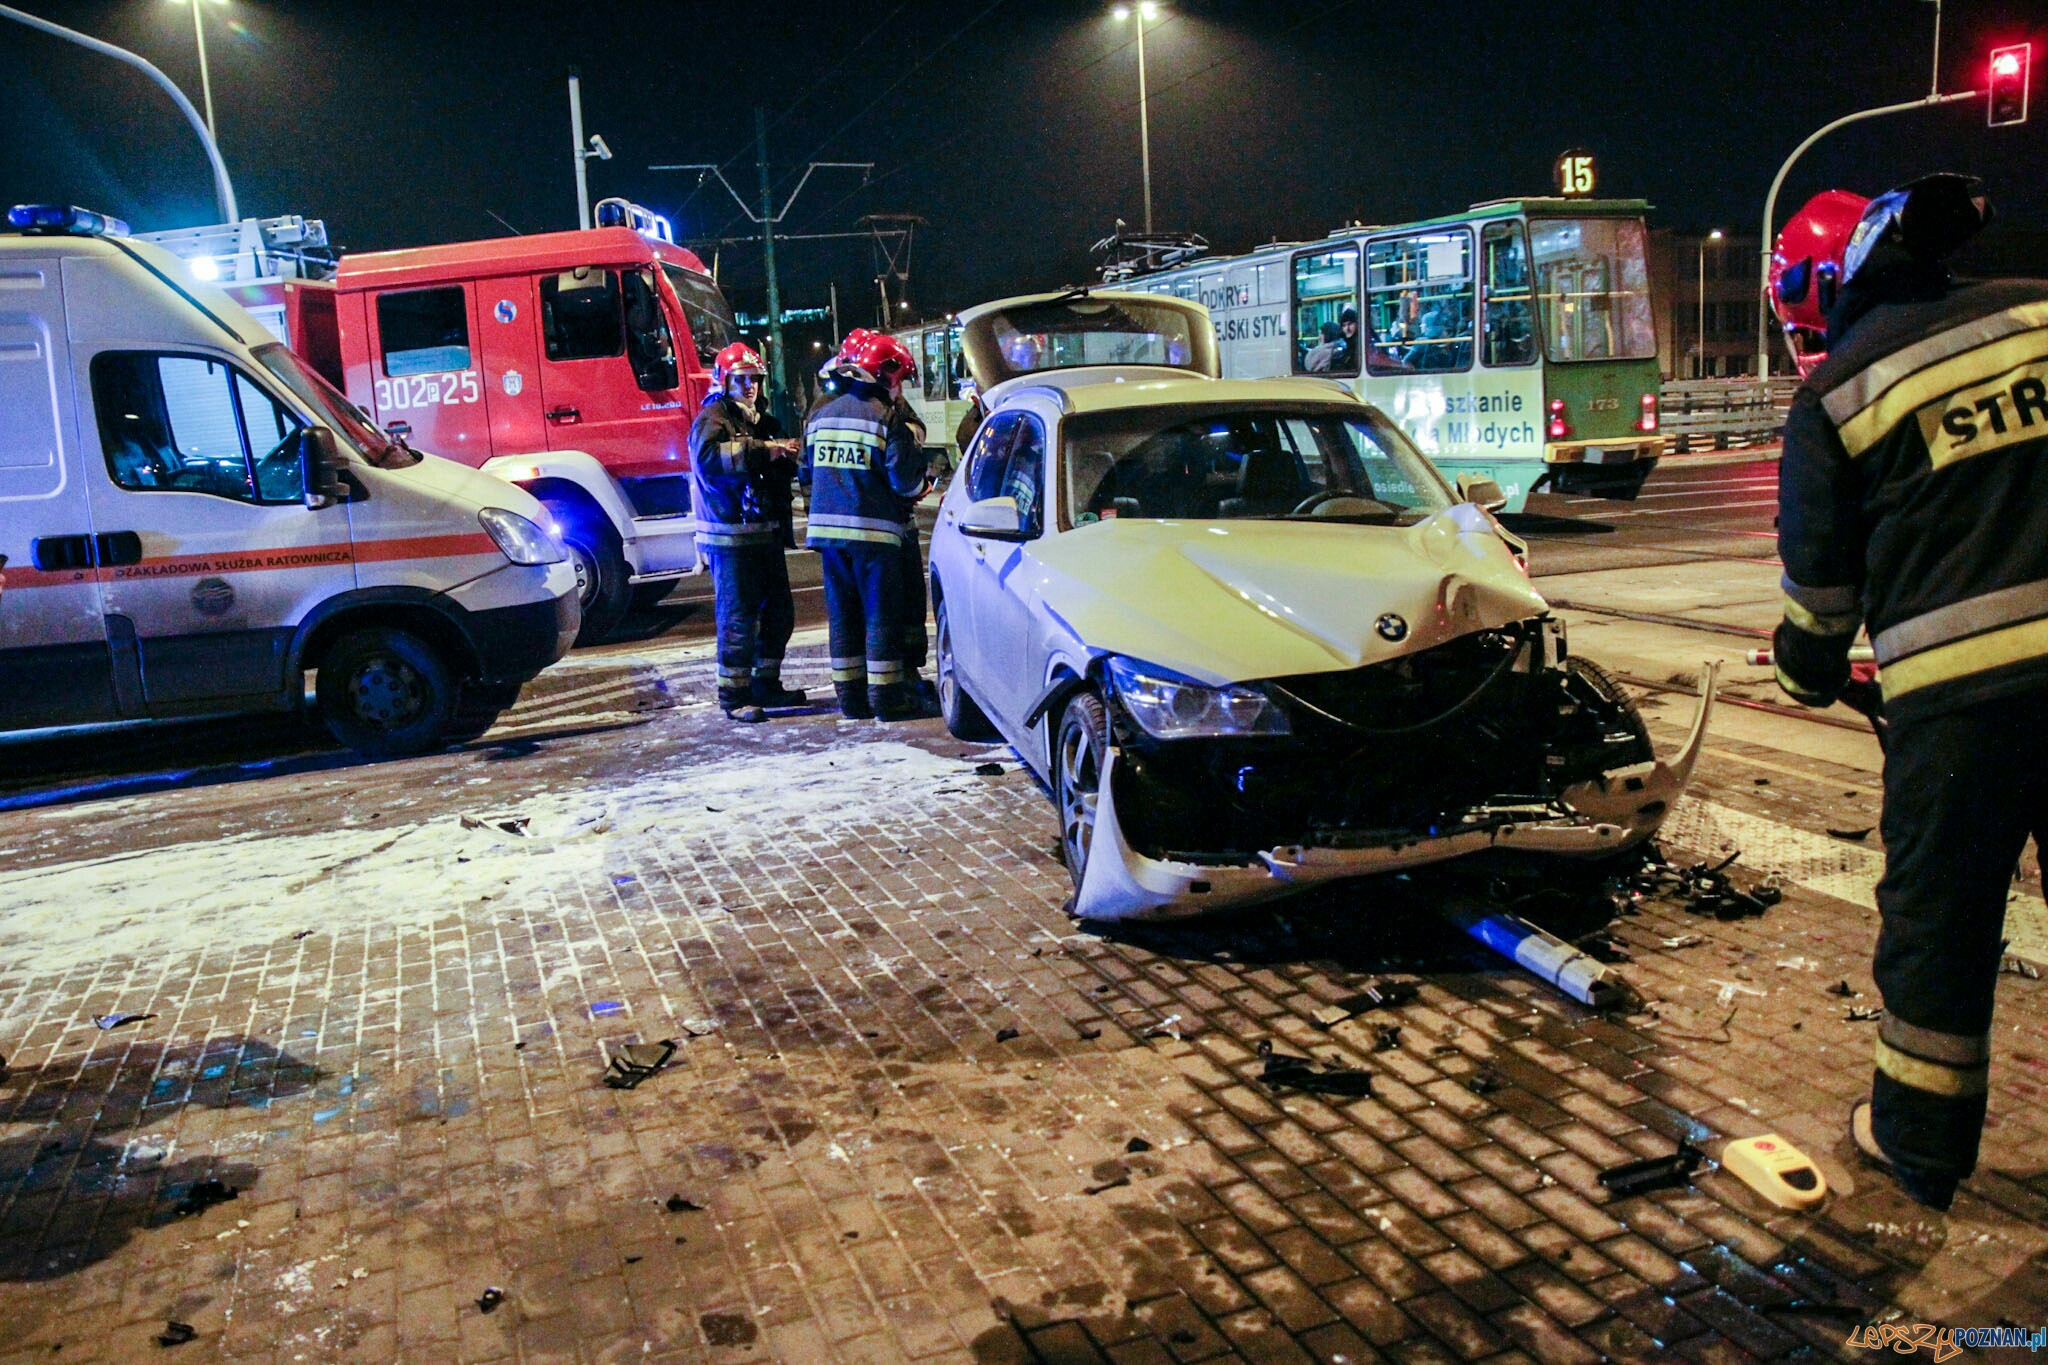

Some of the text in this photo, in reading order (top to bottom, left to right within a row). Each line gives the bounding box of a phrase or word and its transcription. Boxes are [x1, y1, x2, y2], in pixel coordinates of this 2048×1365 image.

[1561, 157, 1593, 193] 15
[1201, 283, 1248, 310] ODKRYJ
[1215, 314, 1287, 341] EJSKI STYL
[1446, 389, 1522, 413] szkanie
[1943, 378, 2048, 449] STR
[266, 551, 350, 566] RATOWNICZA
